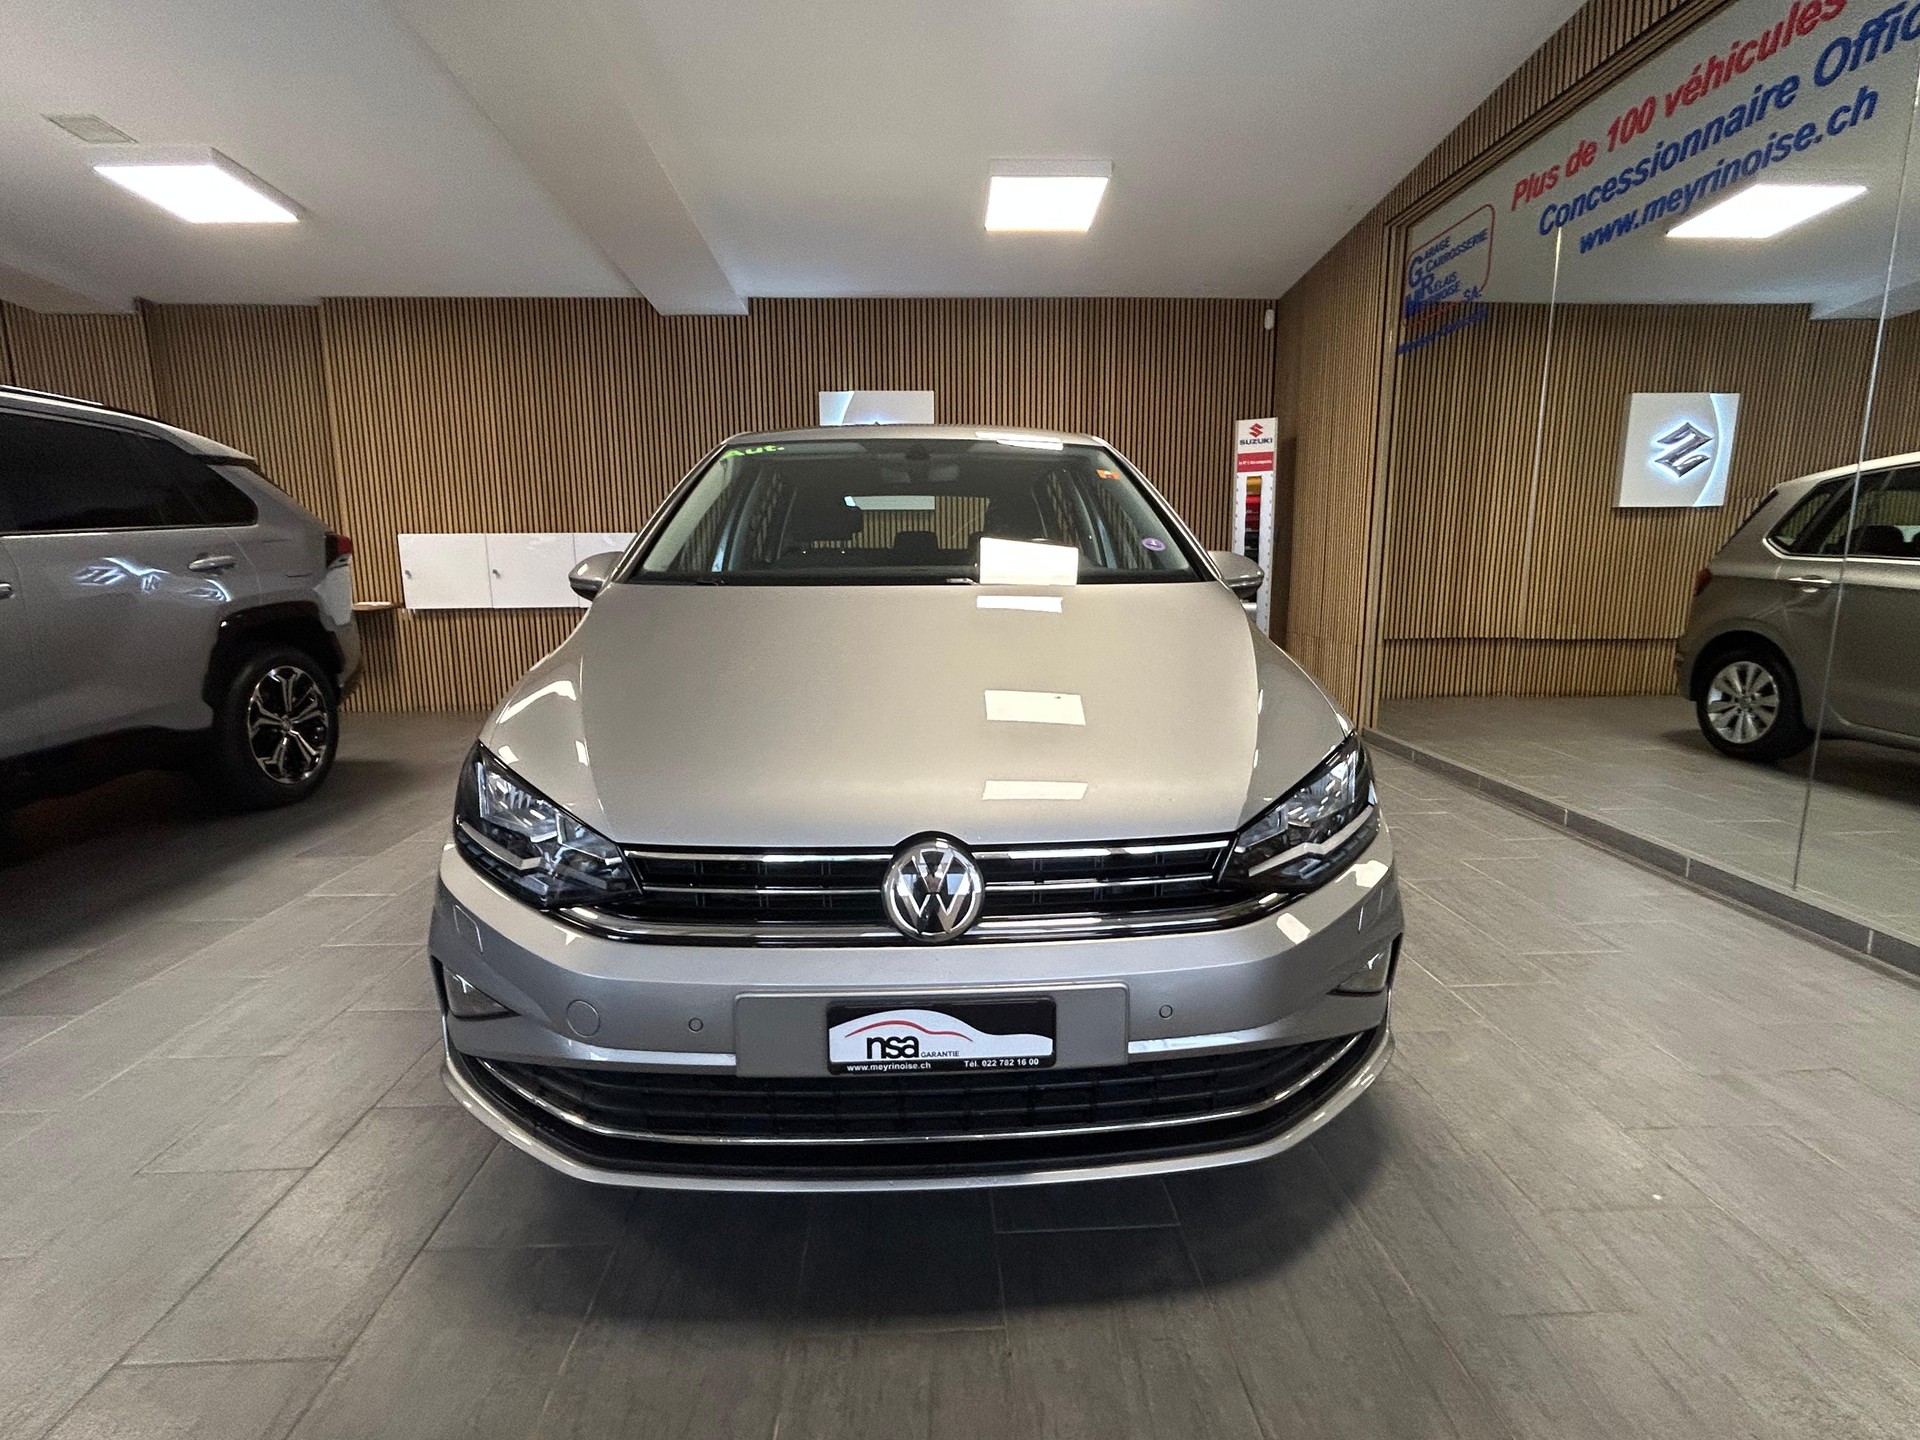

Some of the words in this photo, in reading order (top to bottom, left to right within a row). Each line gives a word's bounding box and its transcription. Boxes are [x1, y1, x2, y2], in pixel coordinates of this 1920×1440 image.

[1510, 163, 1561, 212] Plus
[1564, 139, 1599, 178] de
[1607, 96, 1657, 152] 100
[1665, 0, 1848, 118] véhicules
[1538, 74, 1801, 237] Concessionnaire
[1578, 84, 1880, 255] www.meyrinoise.ch
[1239, 437, 1274, 446] SUZUKI
[846, 1061, 932, 1072] www.meyrinoise.ch
[981, 1059, 998, 1067] 022
[999, 1059, 1015, 1067] 782
[1017, 1058, 1027, 1066] 16
[1028, 1057, 1040, 1066] 00
[866, 1035, 920, 1060] nsa
[920, 1050, 960, 1058] GARANTIE
